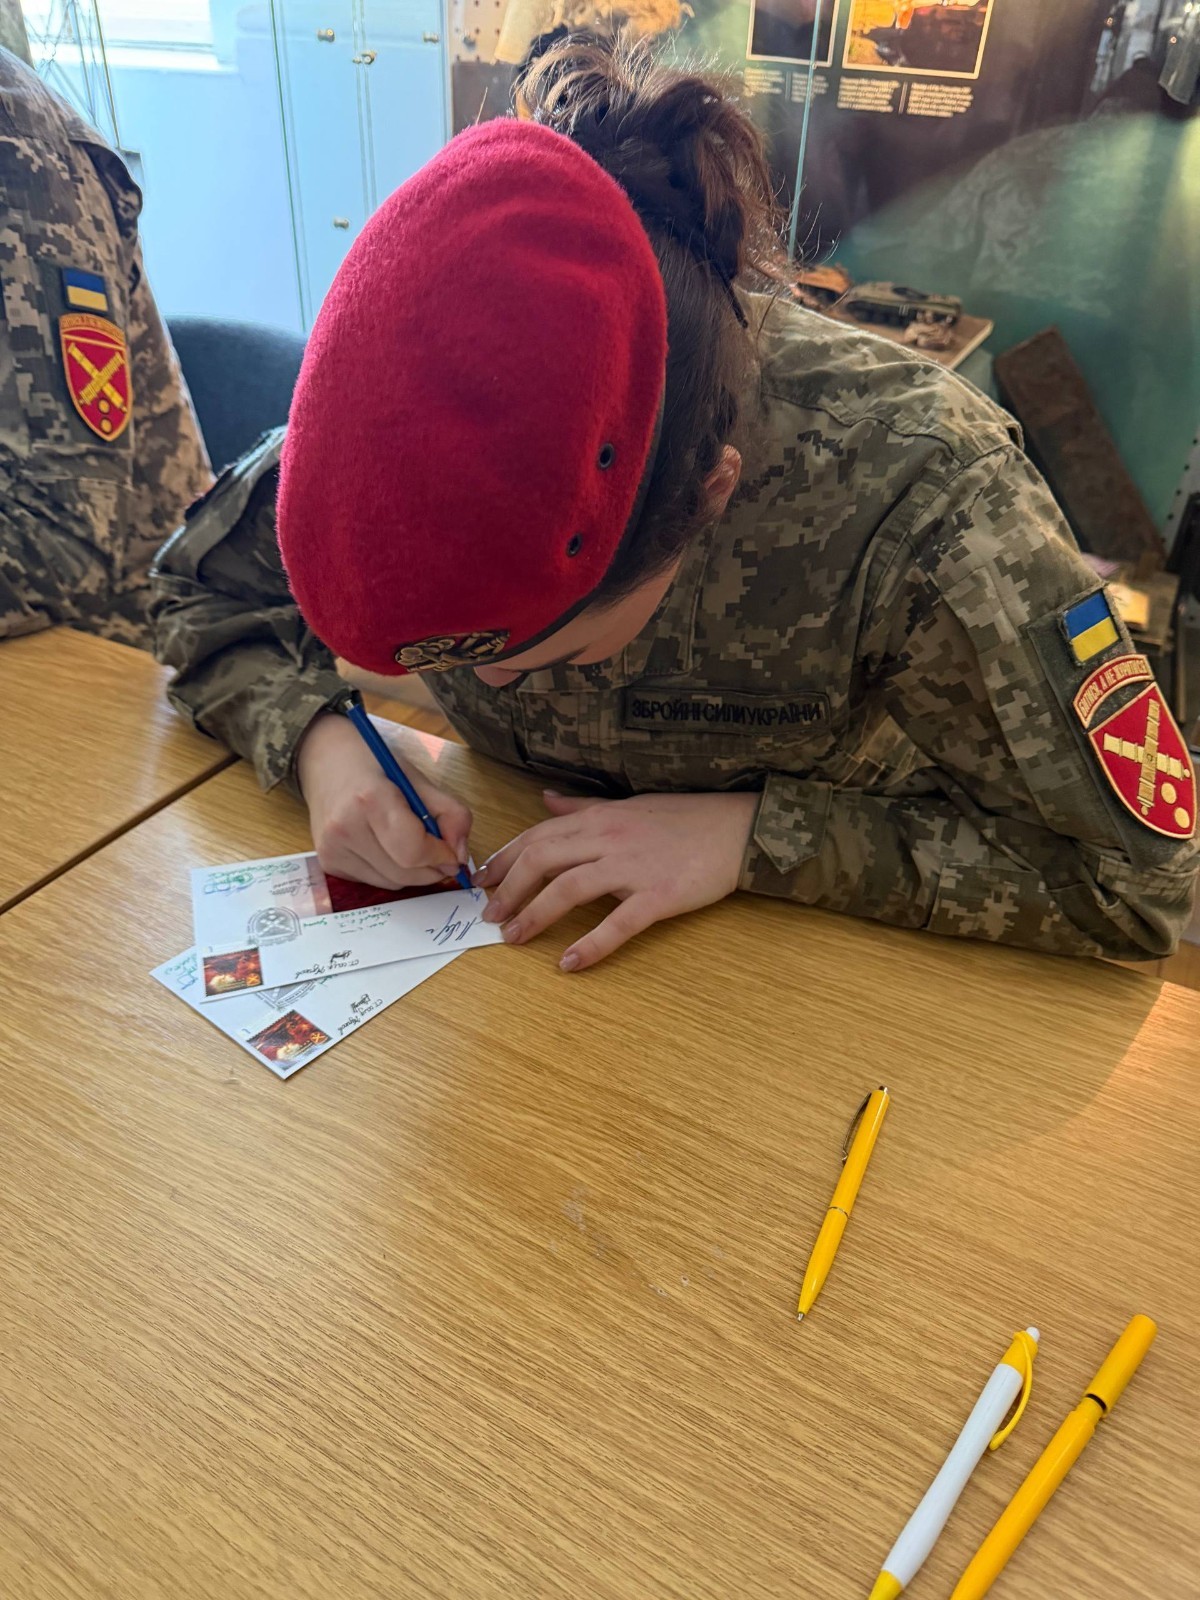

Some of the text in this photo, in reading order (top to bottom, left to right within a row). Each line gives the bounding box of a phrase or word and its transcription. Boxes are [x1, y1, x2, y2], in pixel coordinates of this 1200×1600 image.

[632, 699, 822, 726] ЗБРОЙНІ СИЛИ УКРАЇНИ
